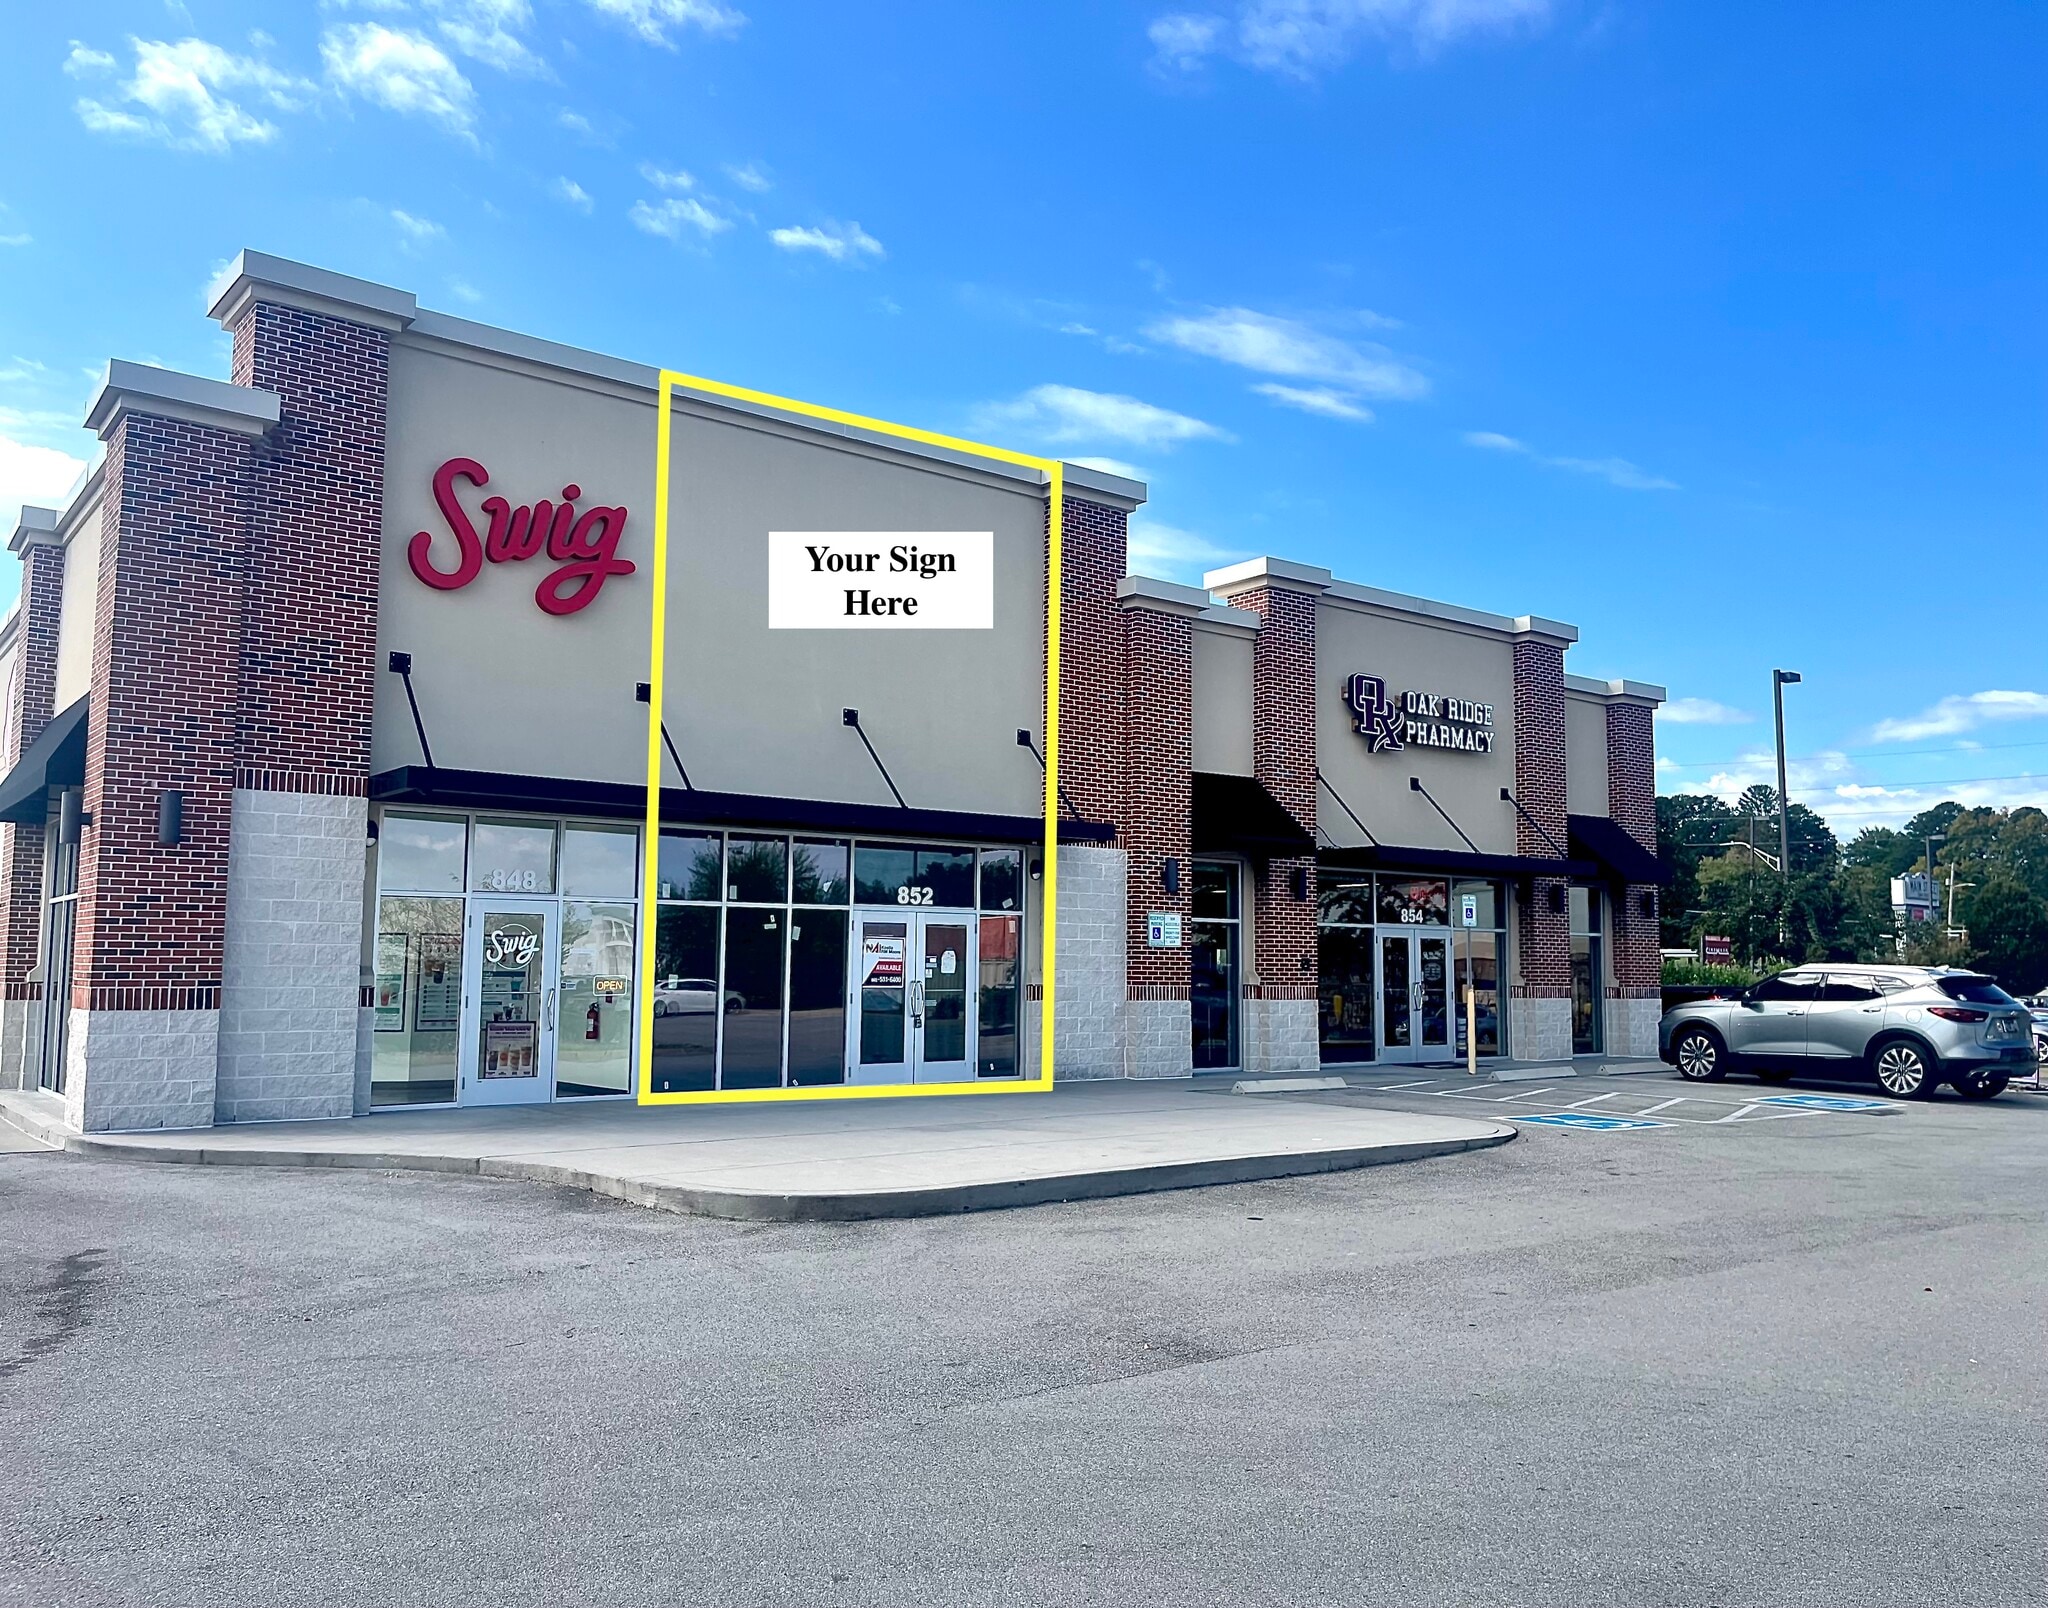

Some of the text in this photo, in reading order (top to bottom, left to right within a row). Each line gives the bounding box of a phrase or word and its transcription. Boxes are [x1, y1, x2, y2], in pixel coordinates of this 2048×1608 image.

[407, 457, 637, 616] Swig
[1406, 691, 1494, 726] OAK RIDGE
[1405, 720, 1495, 753] PHARMACY
[491, 869, 536, 890] 848
[897, 886, 934, 905] 852
[1400, 908, 1424, 924] 854
[486, 930, 540, 964] Swig
[596, 980, 623, 991] OPEN
